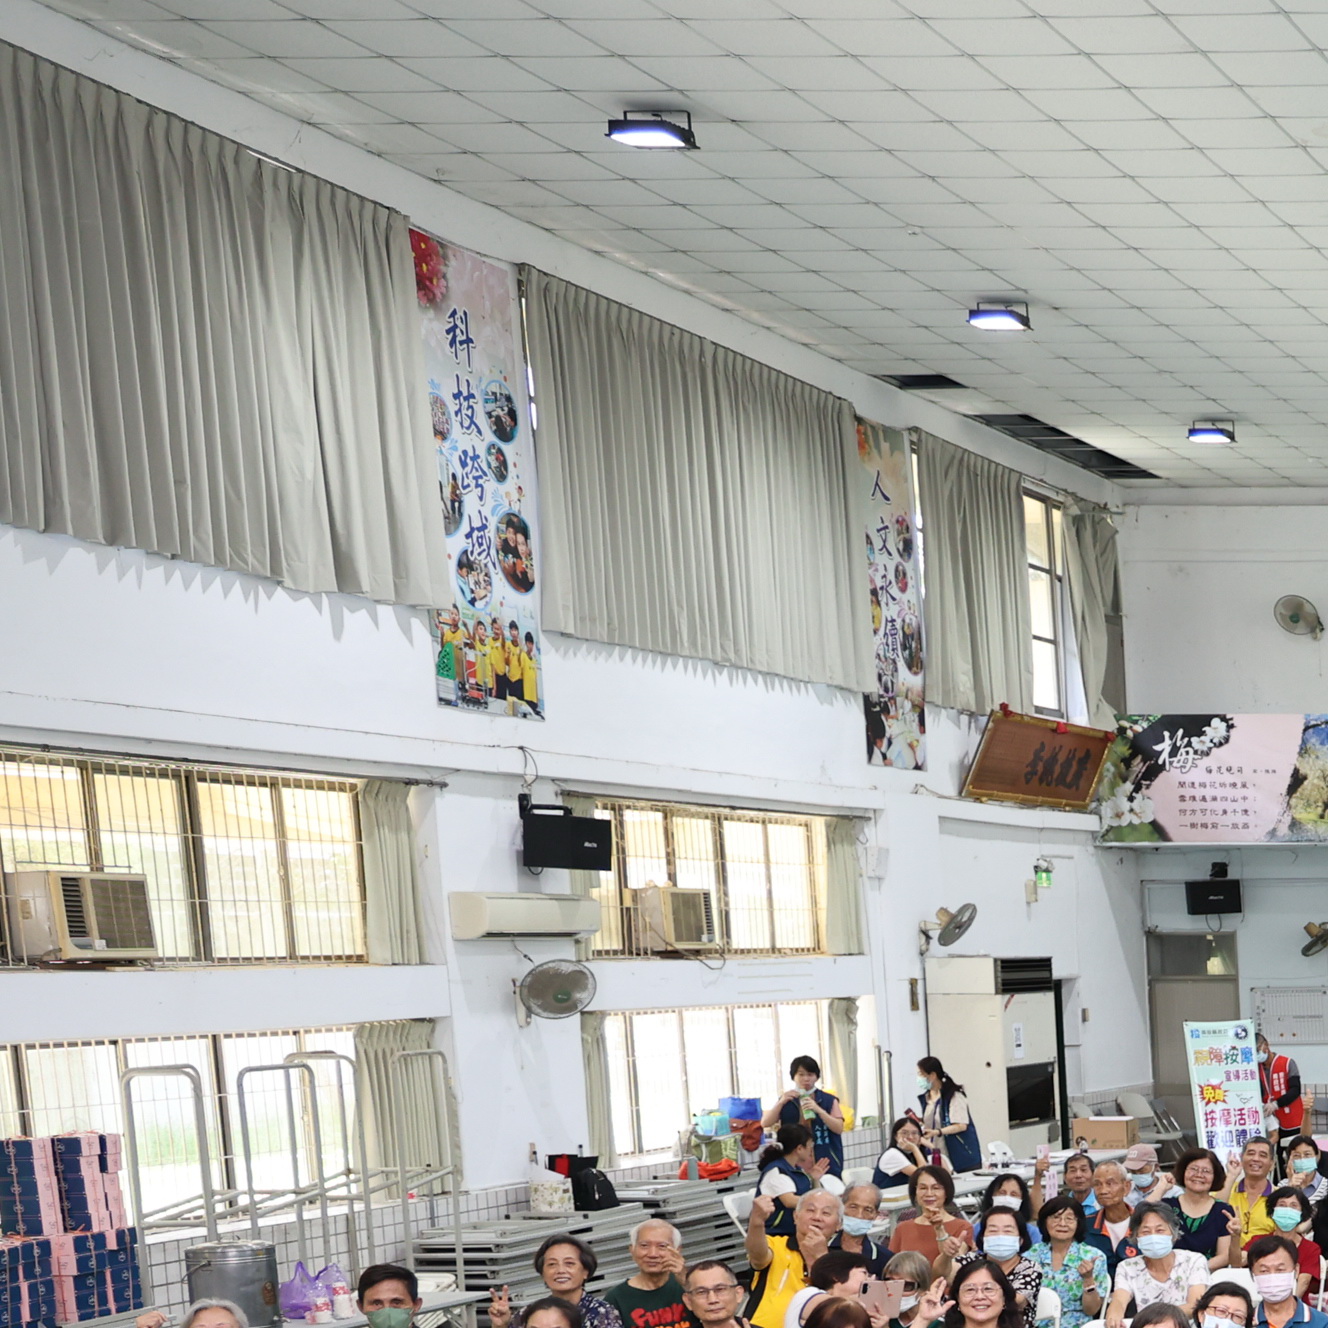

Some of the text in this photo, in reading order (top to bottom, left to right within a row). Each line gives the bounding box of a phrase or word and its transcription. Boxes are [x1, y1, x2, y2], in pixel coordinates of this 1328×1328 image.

[445, 307, 499, 574] 科技跨域
[870, 468, 901, 660] 人文永續
[1152, 728, 1203, 774] 梅
[1224, 1069, 1257, 1082] 宣導活動
[1204, 1107, 1260, 1128] 按摩活動
